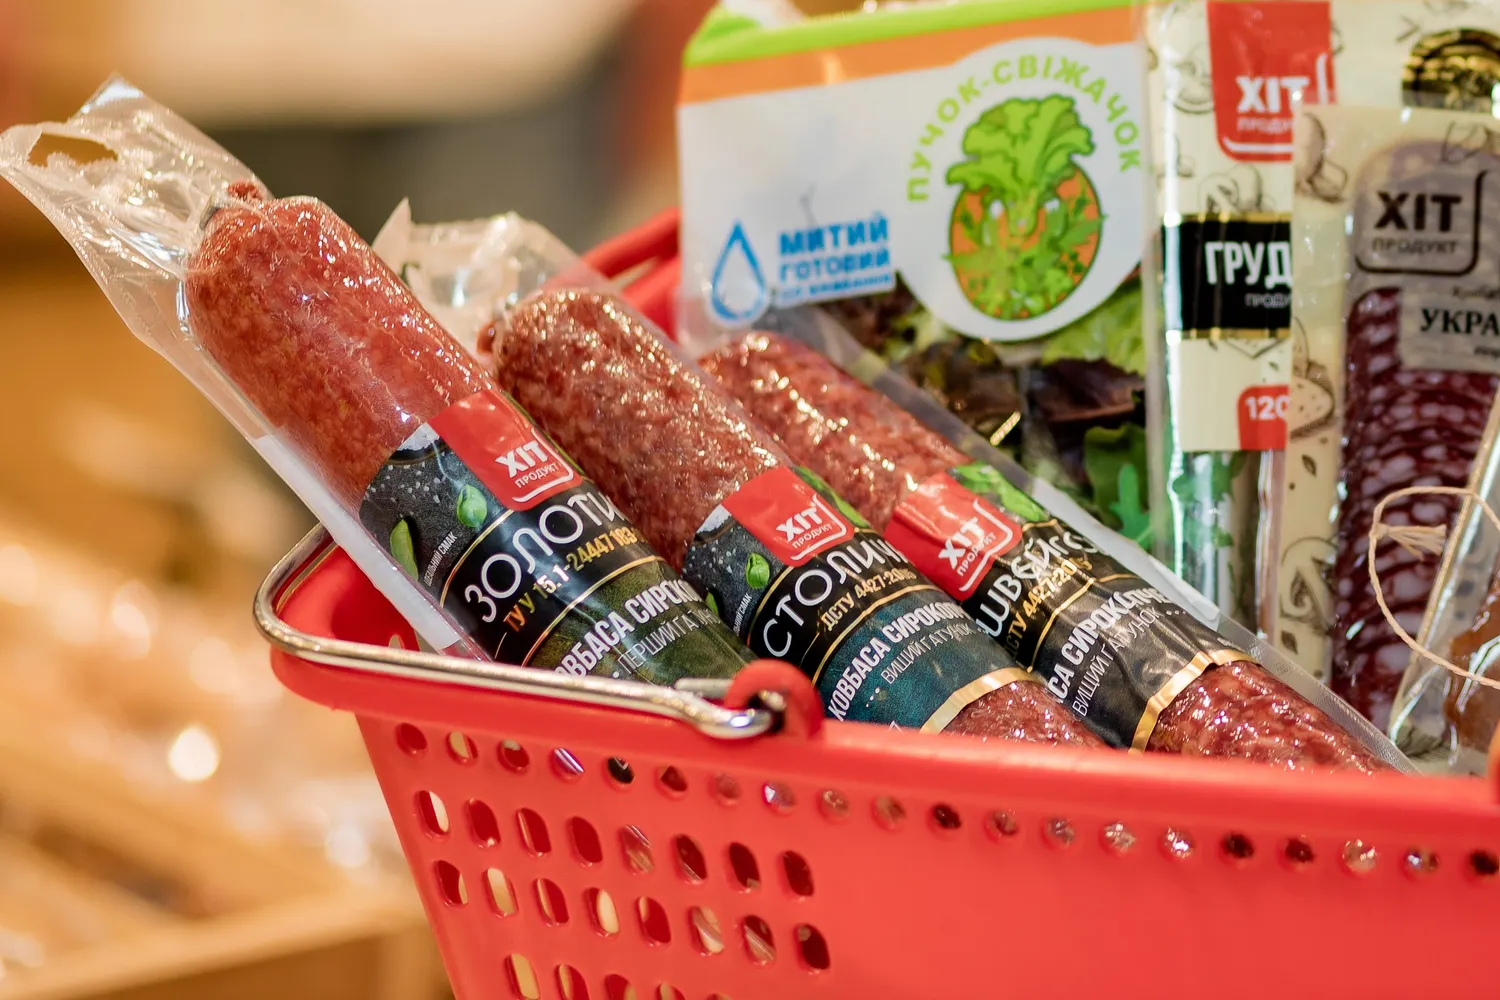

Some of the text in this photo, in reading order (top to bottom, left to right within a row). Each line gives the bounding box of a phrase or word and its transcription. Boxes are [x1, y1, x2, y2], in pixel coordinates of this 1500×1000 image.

[1374, 191, 1463, 233] ХІТ
[496, 440, 550, 478] ХІТ
[515, 462, 559, 489] ПРОДУКТ
[776, 500, 819, 543] ХІТ
[792, 521, 834, 550] ПРОДУКТ
[438, 531, 458, 555] СМАК
[821, 595, 856, 631] ДСТУ
[828, 637, 891, 722] КОВБАСА
